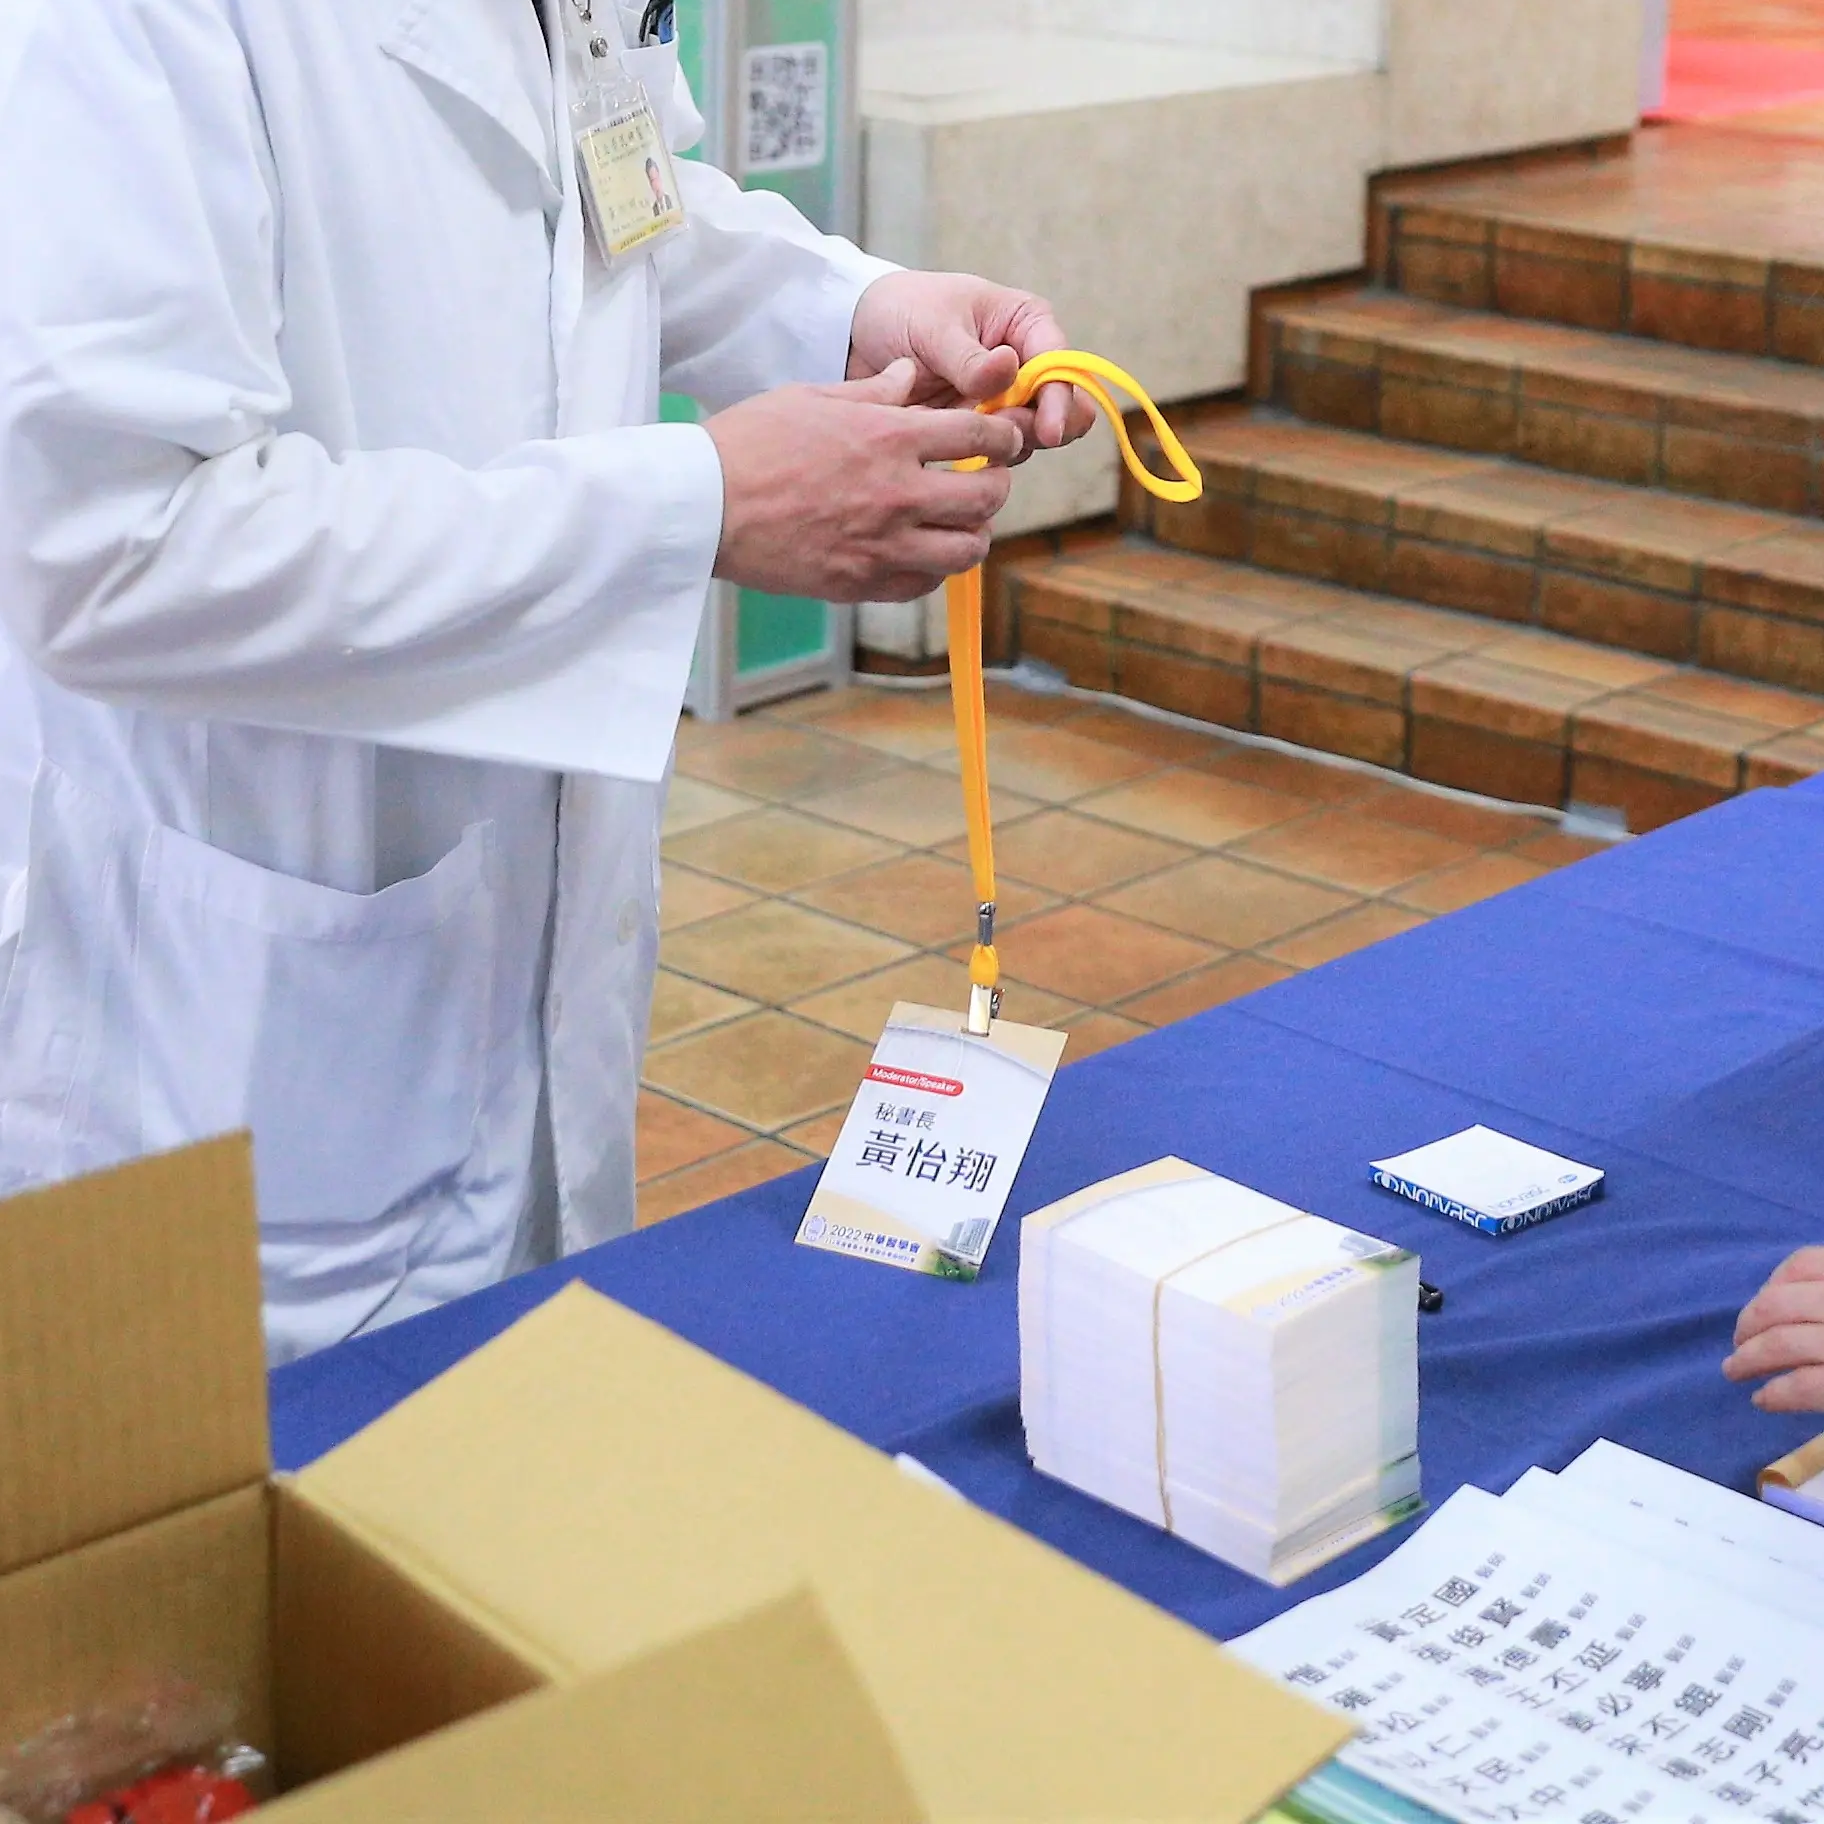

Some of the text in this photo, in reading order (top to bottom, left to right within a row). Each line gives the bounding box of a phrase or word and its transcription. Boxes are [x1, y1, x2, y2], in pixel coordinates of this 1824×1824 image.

[872, 1067, 957, 1094] Moderator/Speaker
[875, 1101, 937, 1131] 秘書長
[855, 1129, 999, 1194] 黃怡翔
[829, 1224, 862, 1242] 2022
